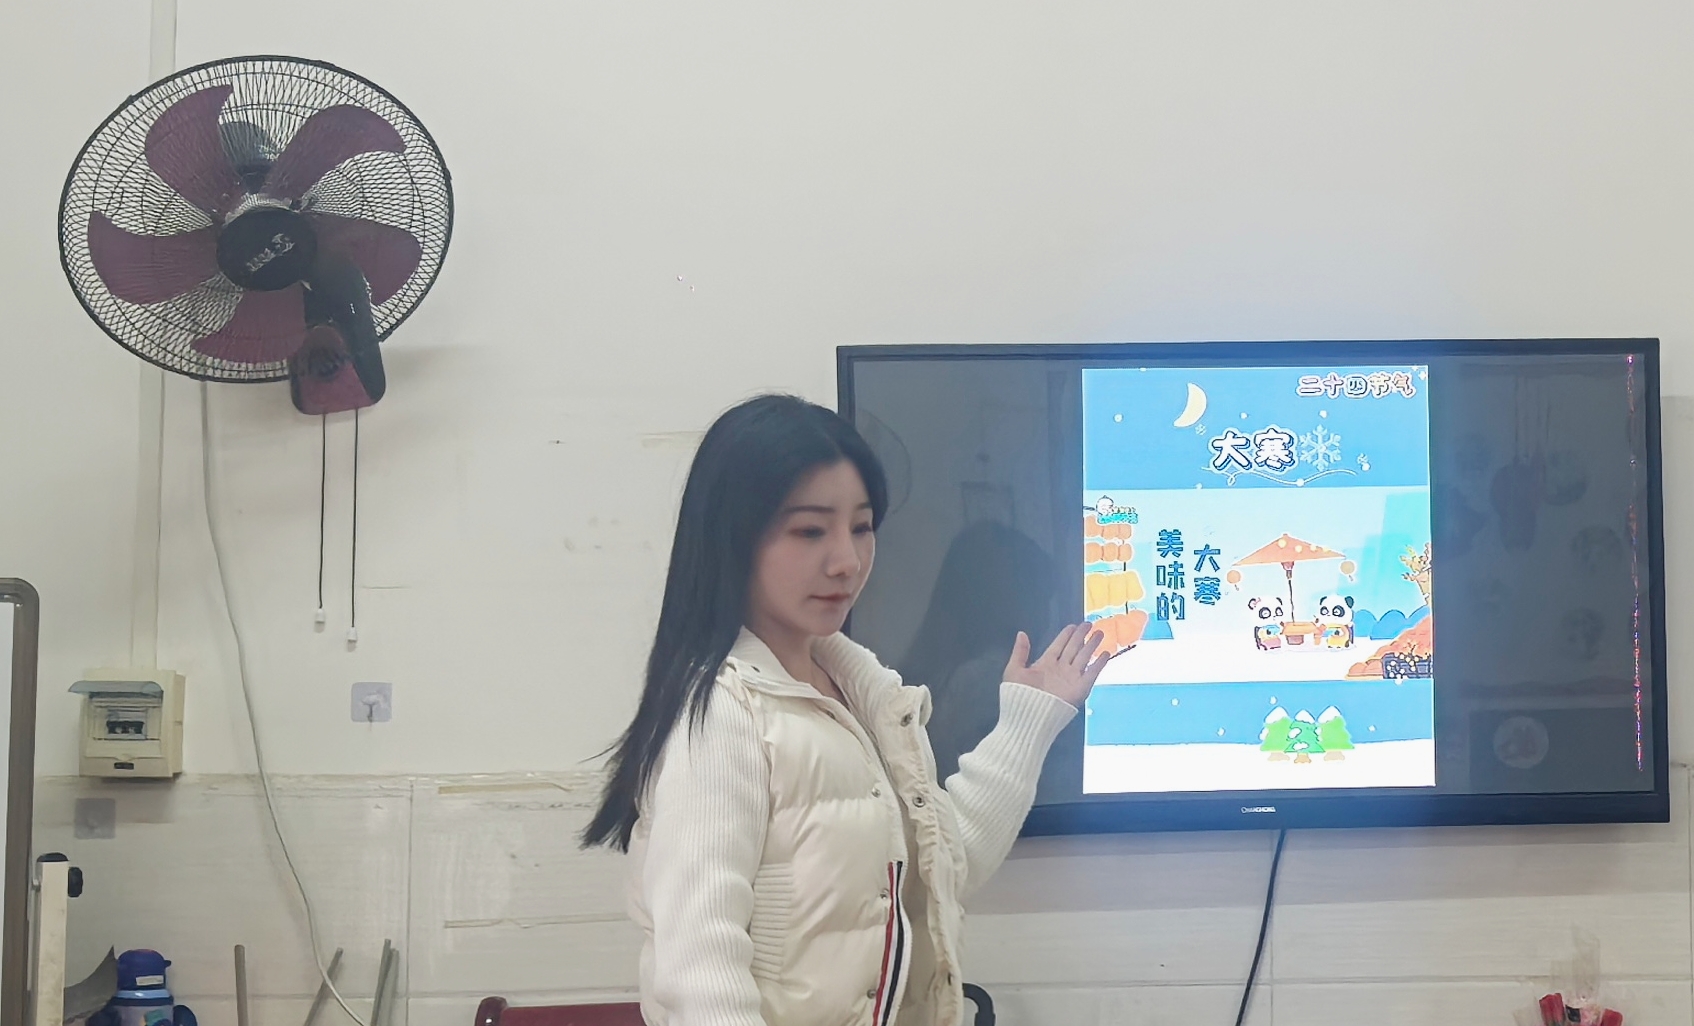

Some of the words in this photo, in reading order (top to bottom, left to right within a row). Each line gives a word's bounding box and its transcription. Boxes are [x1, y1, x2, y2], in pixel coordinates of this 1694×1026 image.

[1298, 371, 1415, 397] 二十四节气
[1211, 428, 1297, 469] 大寒
[1156, 529, 1186, 621] 美味的
[1193, 543, 1222, 605] 大寒
